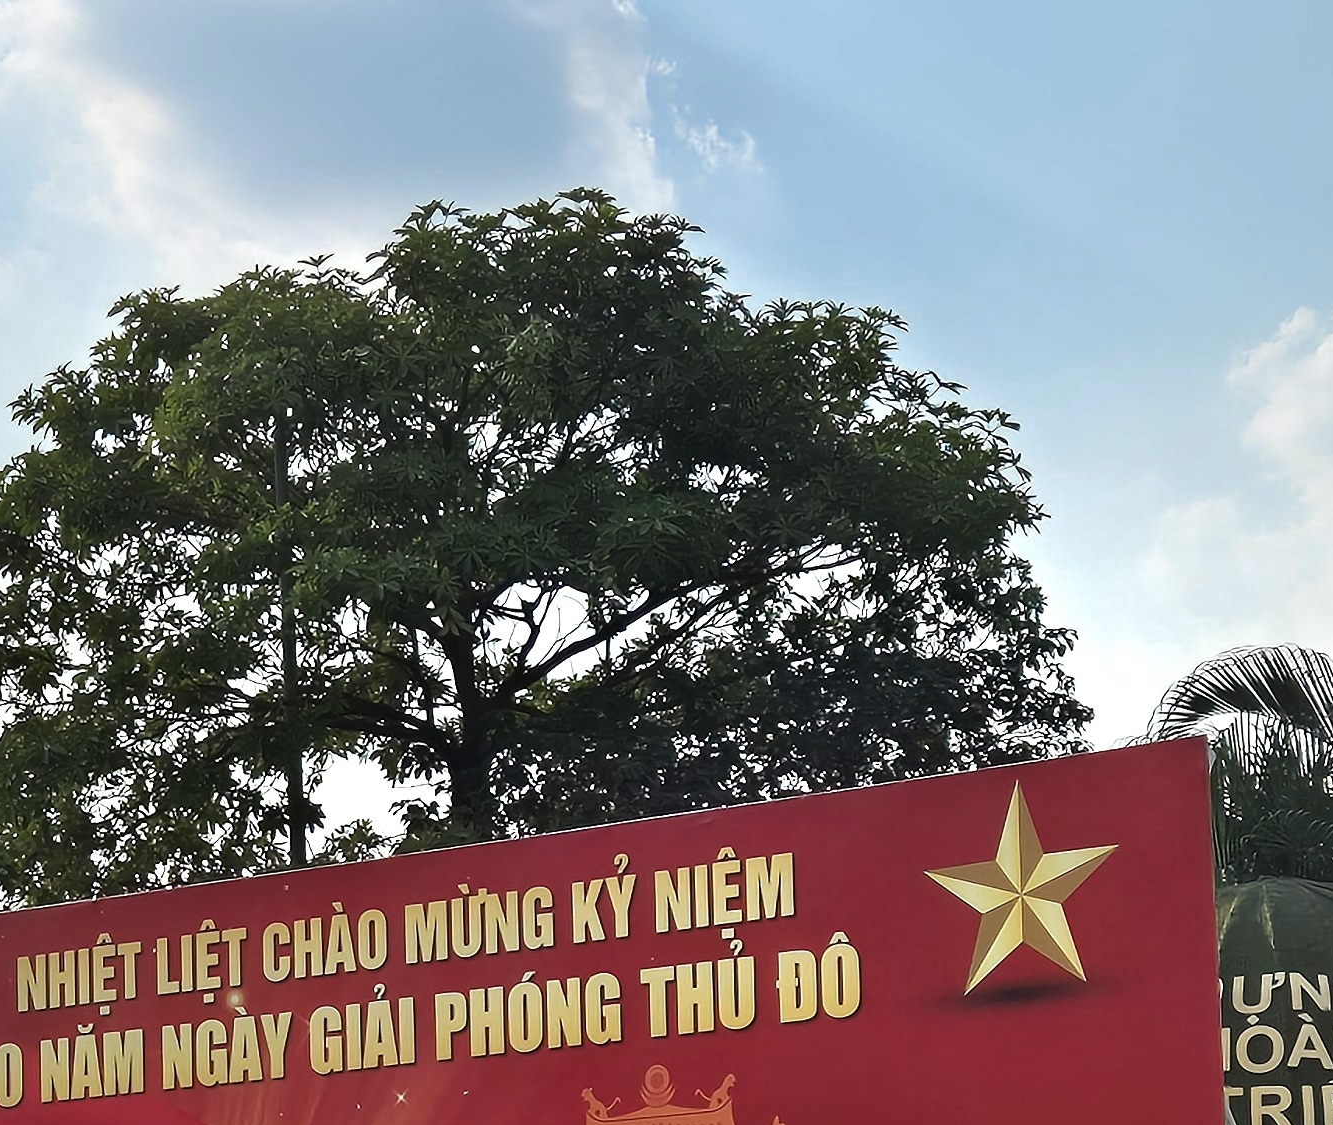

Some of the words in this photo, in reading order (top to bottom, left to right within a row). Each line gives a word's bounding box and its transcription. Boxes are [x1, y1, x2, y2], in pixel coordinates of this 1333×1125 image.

[17, 933, 142, 1016] NHIỆT
[156, 918, 247, 1003] LIỆT
[262, 902, 388, 982] CHÀO
[404, 884, 555, 964] MỪNG
[571, 853, 637, 944] KỶ
[654, 846, 796, 940] NIỆM
[40, 1022, 145, 1103] NĂM
[161, 1006, 293, 1091] NGÀY
[309, 984, 416, 1075] GIẢI
[435, 971, 623, 1061] PHÓNG
[640, 939, 756, 1038] THỦ
[776, 931, 862, 1024] ĐÔ
